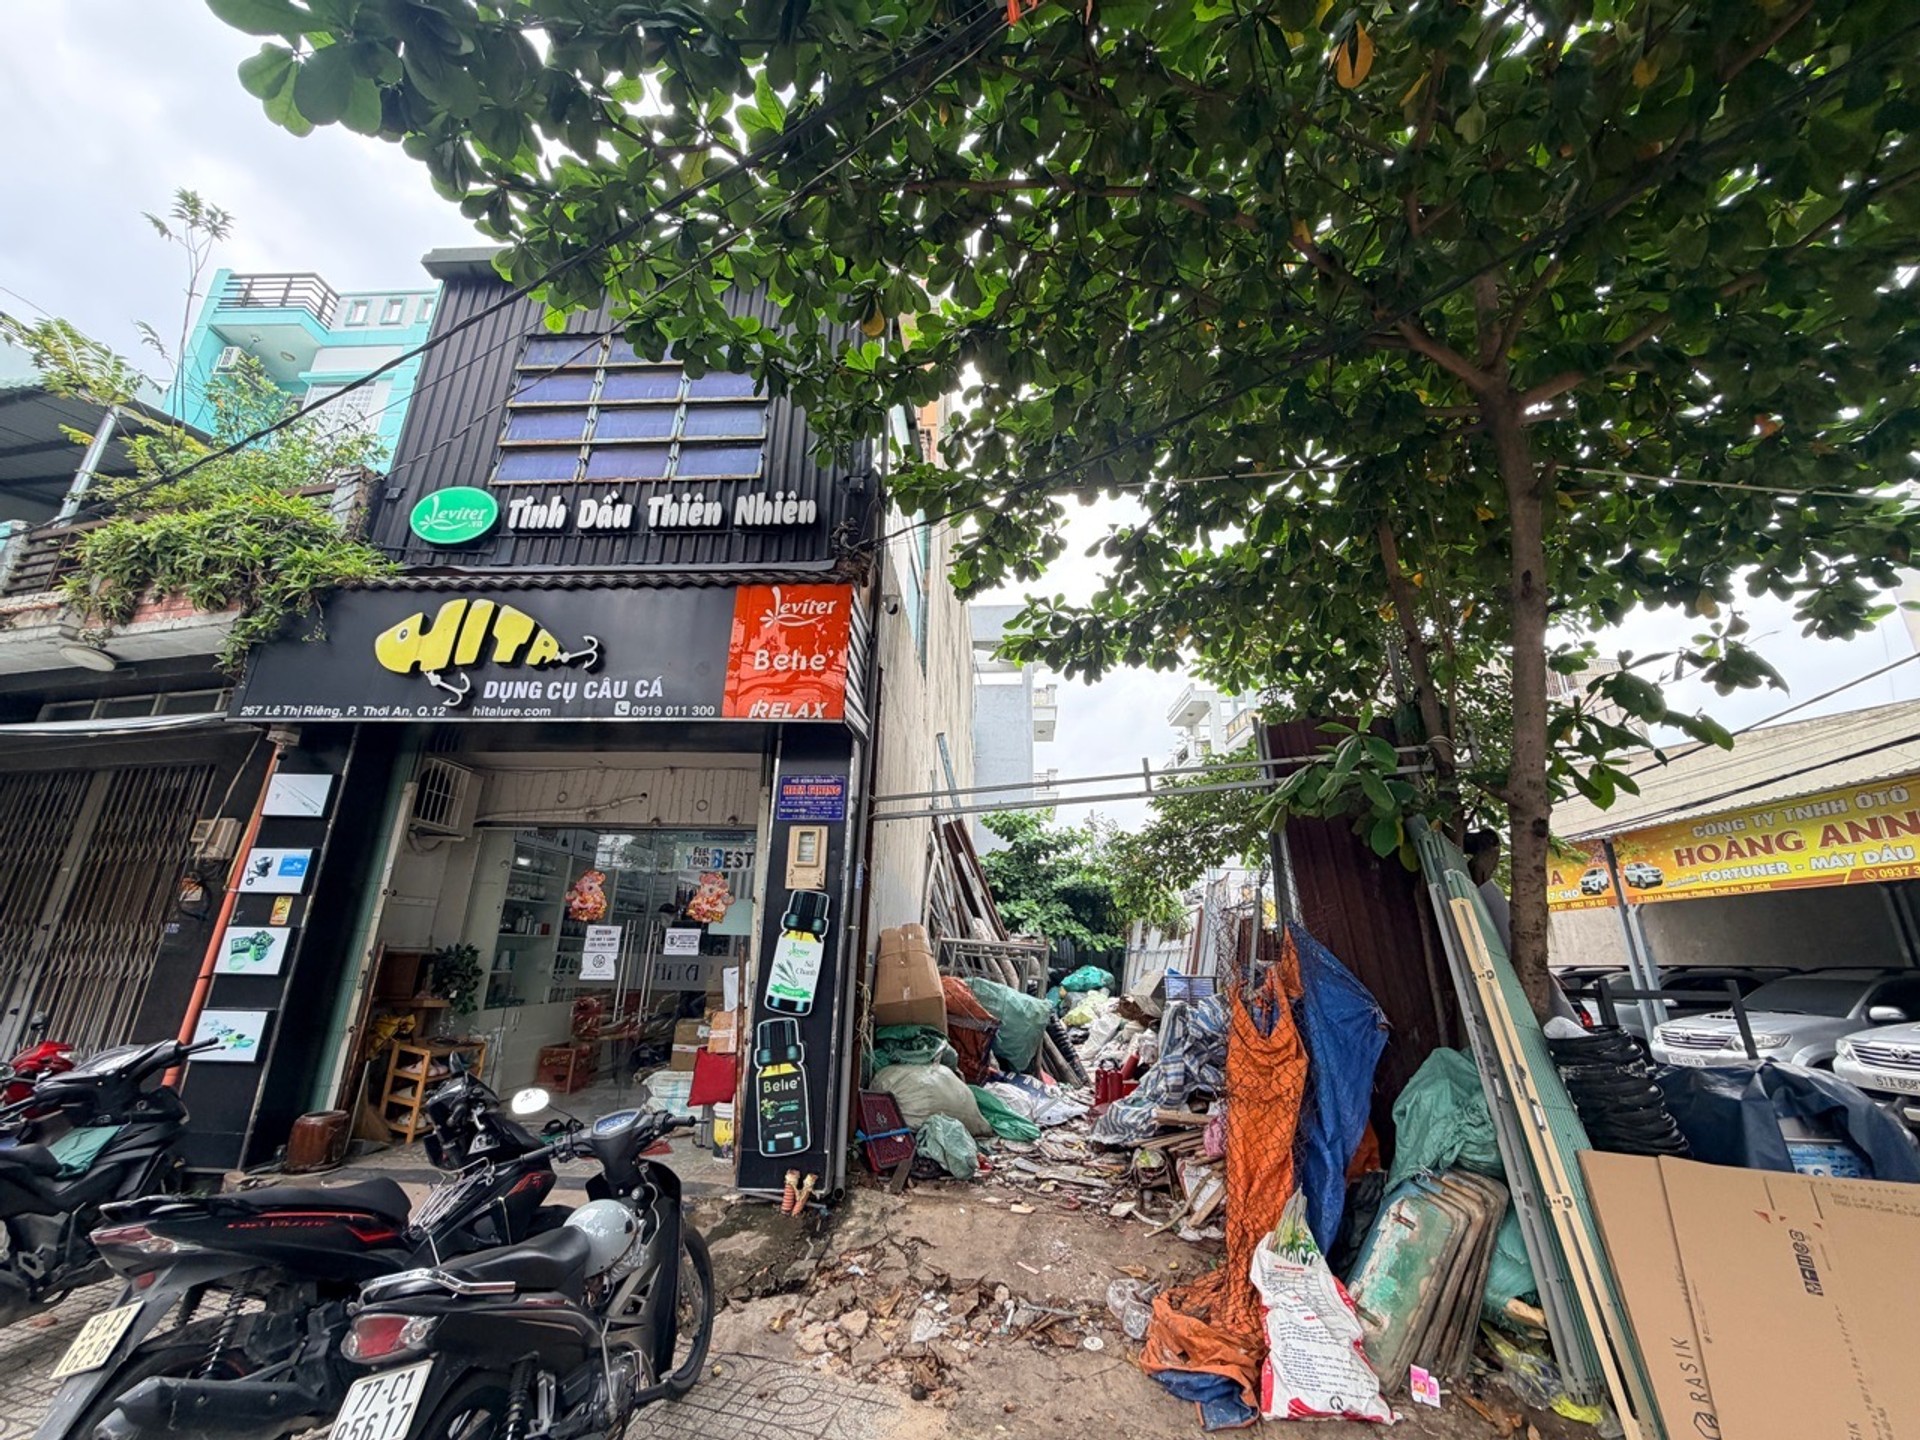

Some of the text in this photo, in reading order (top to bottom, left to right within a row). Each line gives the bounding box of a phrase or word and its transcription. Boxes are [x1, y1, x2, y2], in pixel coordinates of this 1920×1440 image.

[430, 495, 488, 524] Leviter
[508, 490, 816, 529] Tinh Dầu Thiên Nhiên
[768, 586, 837, 620] Leviter
[483, 676, 664, 704] DỤNG CỤ CÂU CÁ
[240, 706, 262, 716] 267
[264, 705, 281, 716] Lê
[283, 705, 302, 718] Thị
[305, 705, 343, 718] Riêng,
[346, 706, 357, 716] P.
[391, 706, 413, 717] An,
[417, 706, 446, 717] Q.12
[472, 706, 551, 717] hitalure.com
[631, 706, 715, 717] 0919 011 300
[1692, 785, 1910, 838] CÔNG TY TNHH ÔTÔ
[712, 848, 754, 869] BEST
[1674, 830, 1805, 867] HOÀNG
[1701, 862, 1791, 882] FORTUNER
[1810, 851, 1856, 870] MÁY
[1879, 866, 1909, 878] 0937
[1670, 1337, 1710, 1403] RASIK
[352, 1370, 416, 1416] 77-C1
